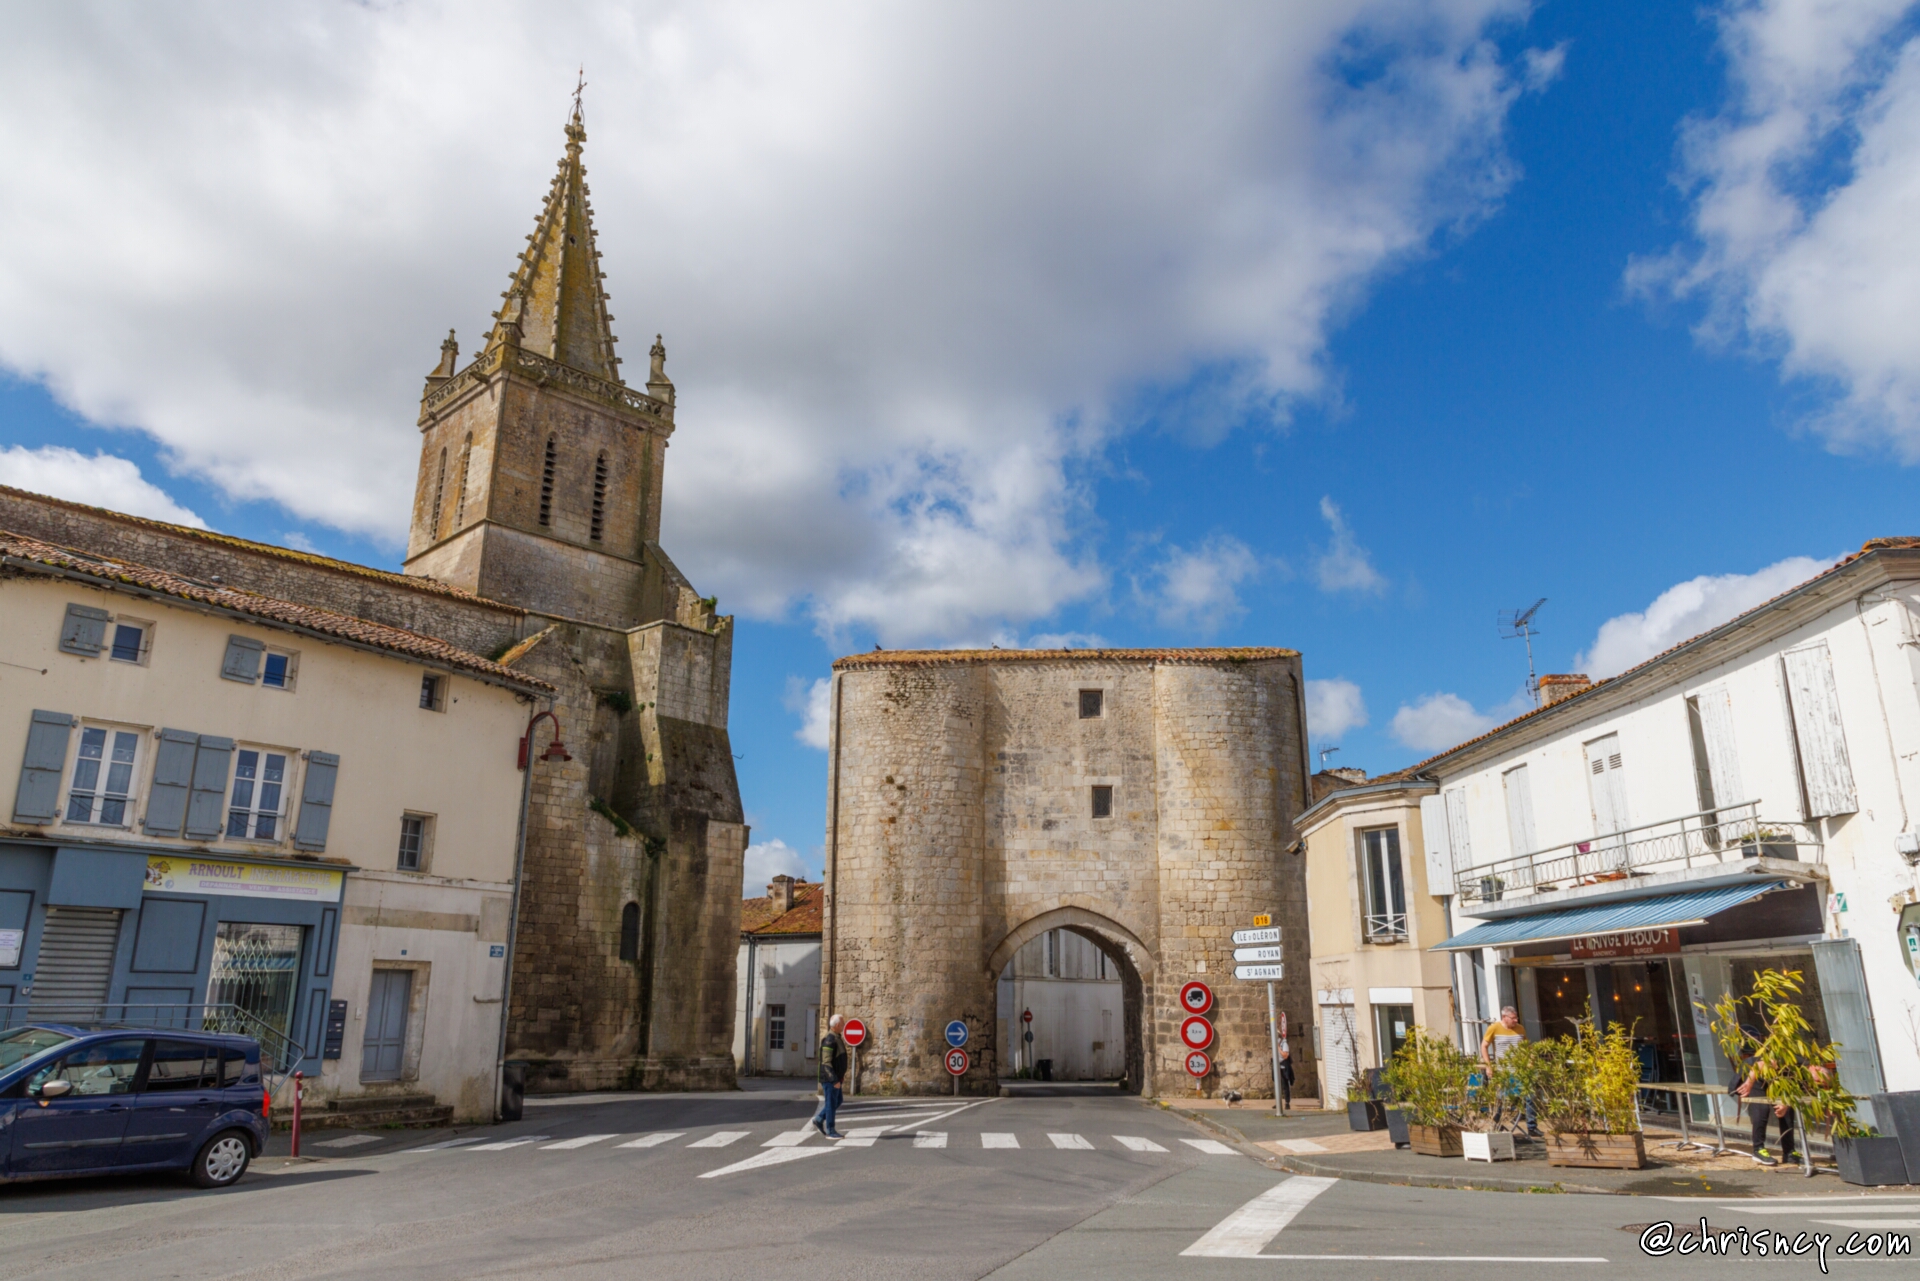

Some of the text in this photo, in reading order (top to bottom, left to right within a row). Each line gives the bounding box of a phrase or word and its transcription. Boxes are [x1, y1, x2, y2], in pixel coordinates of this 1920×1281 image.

[188, 863, 331, 886] ARNOULT INFORMATIQUE
[248, 884, 270, 892] VENTE
[277, 886, 316, 895] ASSISTANCE
[1573, 938, 1584, 951] LE
[1258, 950, 1279, 958] ROYAN
[1633, 947, 1654, 955] BURGER
[1254, 967, 1280, 976] AGNANT
[950, 1055, 964, 1068] 30
